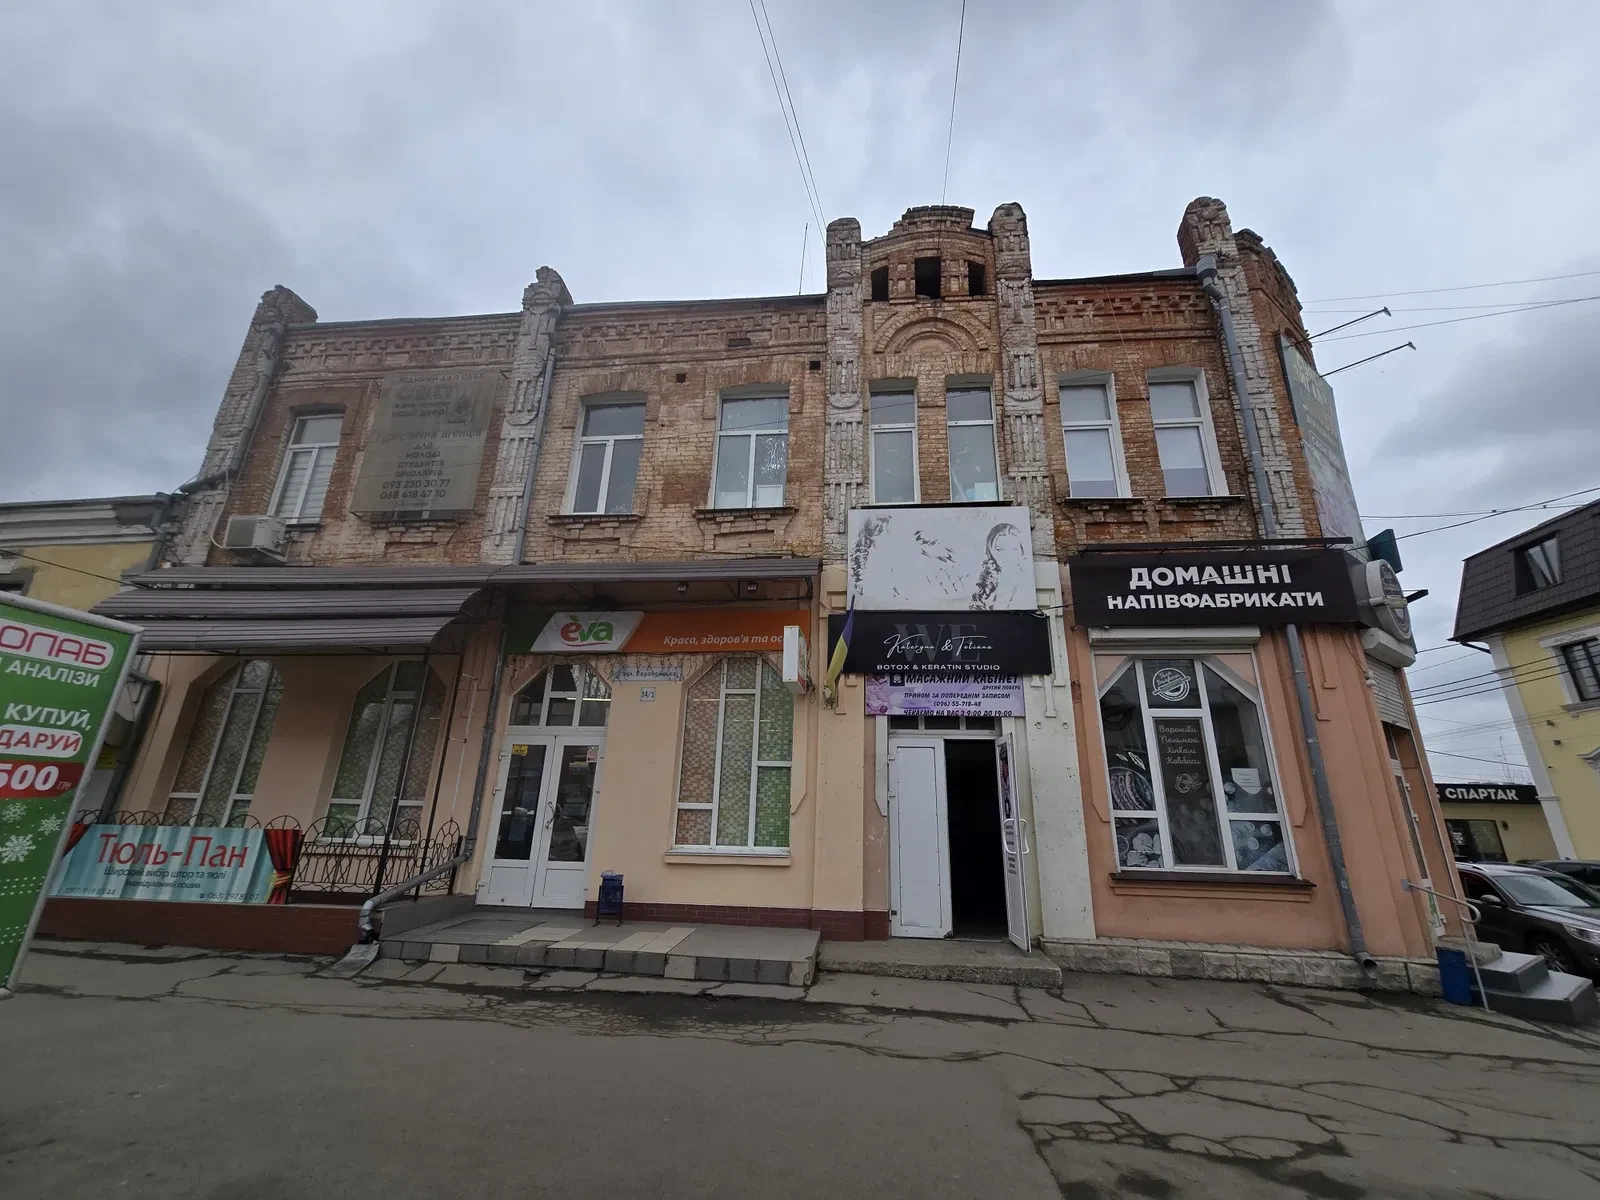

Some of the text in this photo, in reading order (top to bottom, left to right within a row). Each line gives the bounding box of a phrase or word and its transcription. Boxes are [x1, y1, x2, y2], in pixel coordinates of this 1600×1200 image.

[398, 460, 445, 469] СТУДЕНТІВ
[382, 480, 401, 489] 093
[424, 480, 437, 488] 30
[440, 479, 452, 487] 77
[380, 490, 399, 500] 068
[435, 489, 447, 498] 10
[1129, 564, 1292, 590] ДОМАШНІ
[1107, 591, 1325, 610] НАПІВФАБРИКАТИ
[663, 635, 698, 647] Краса,
[700, 634, 749, 646] здоров'я
[751, 635, 768, 643] та
[883, 633, 936, 659] Kateryna
[941, 638, 953, 652] &
[5, 659, 101, 688] АНАЛІЗИ
[973, 673, 1020, 684] КАБІНЕТ
[4, 702, 92, 731] КУПУЙ,
[0, 728, 82, 752] ДАРУЙ
[0, 763, 59, 791] 500
[1445, 787, 1519, 801] СПАРТАК
[98, 833, 250, 869] Тюль-Пан
[104, 866, 227, 881] Широкий вибір штор та тюлі
